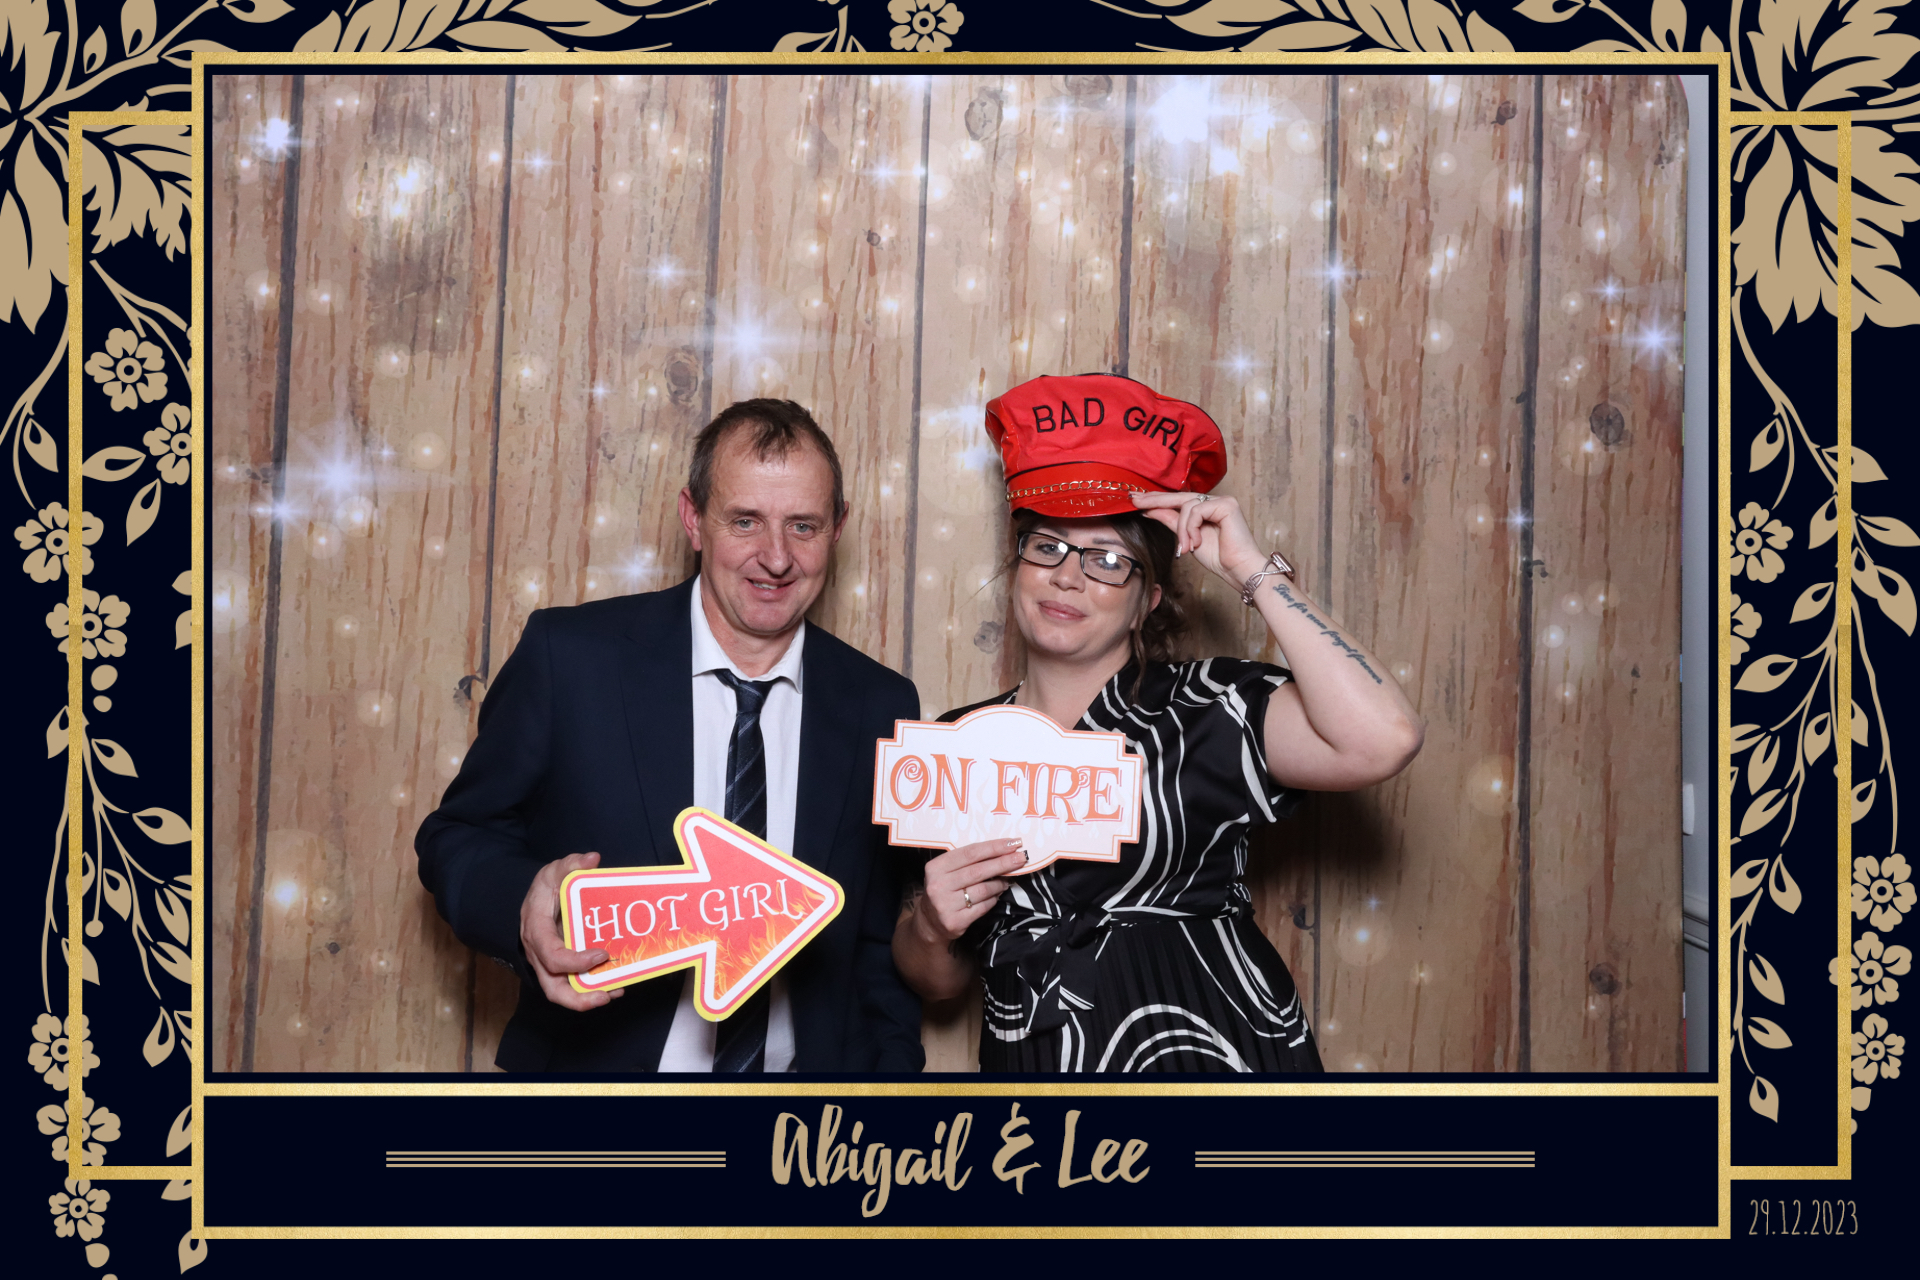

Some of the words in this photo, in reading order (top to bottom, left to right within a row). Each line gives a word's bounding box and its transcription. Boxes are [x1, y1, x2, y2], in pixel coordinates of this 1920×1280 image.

[1032, 397, 1105, 433] BAD
[1123, 406, 1185, 455] GIRL
[1272, 583, 1295, 603] Live
[889, 753, 977, 814] ON
[989, 758, 1124, 826] FIRE
[584, 893, 688, 943] HOT
[699, 878, 805, 931] GIRL
